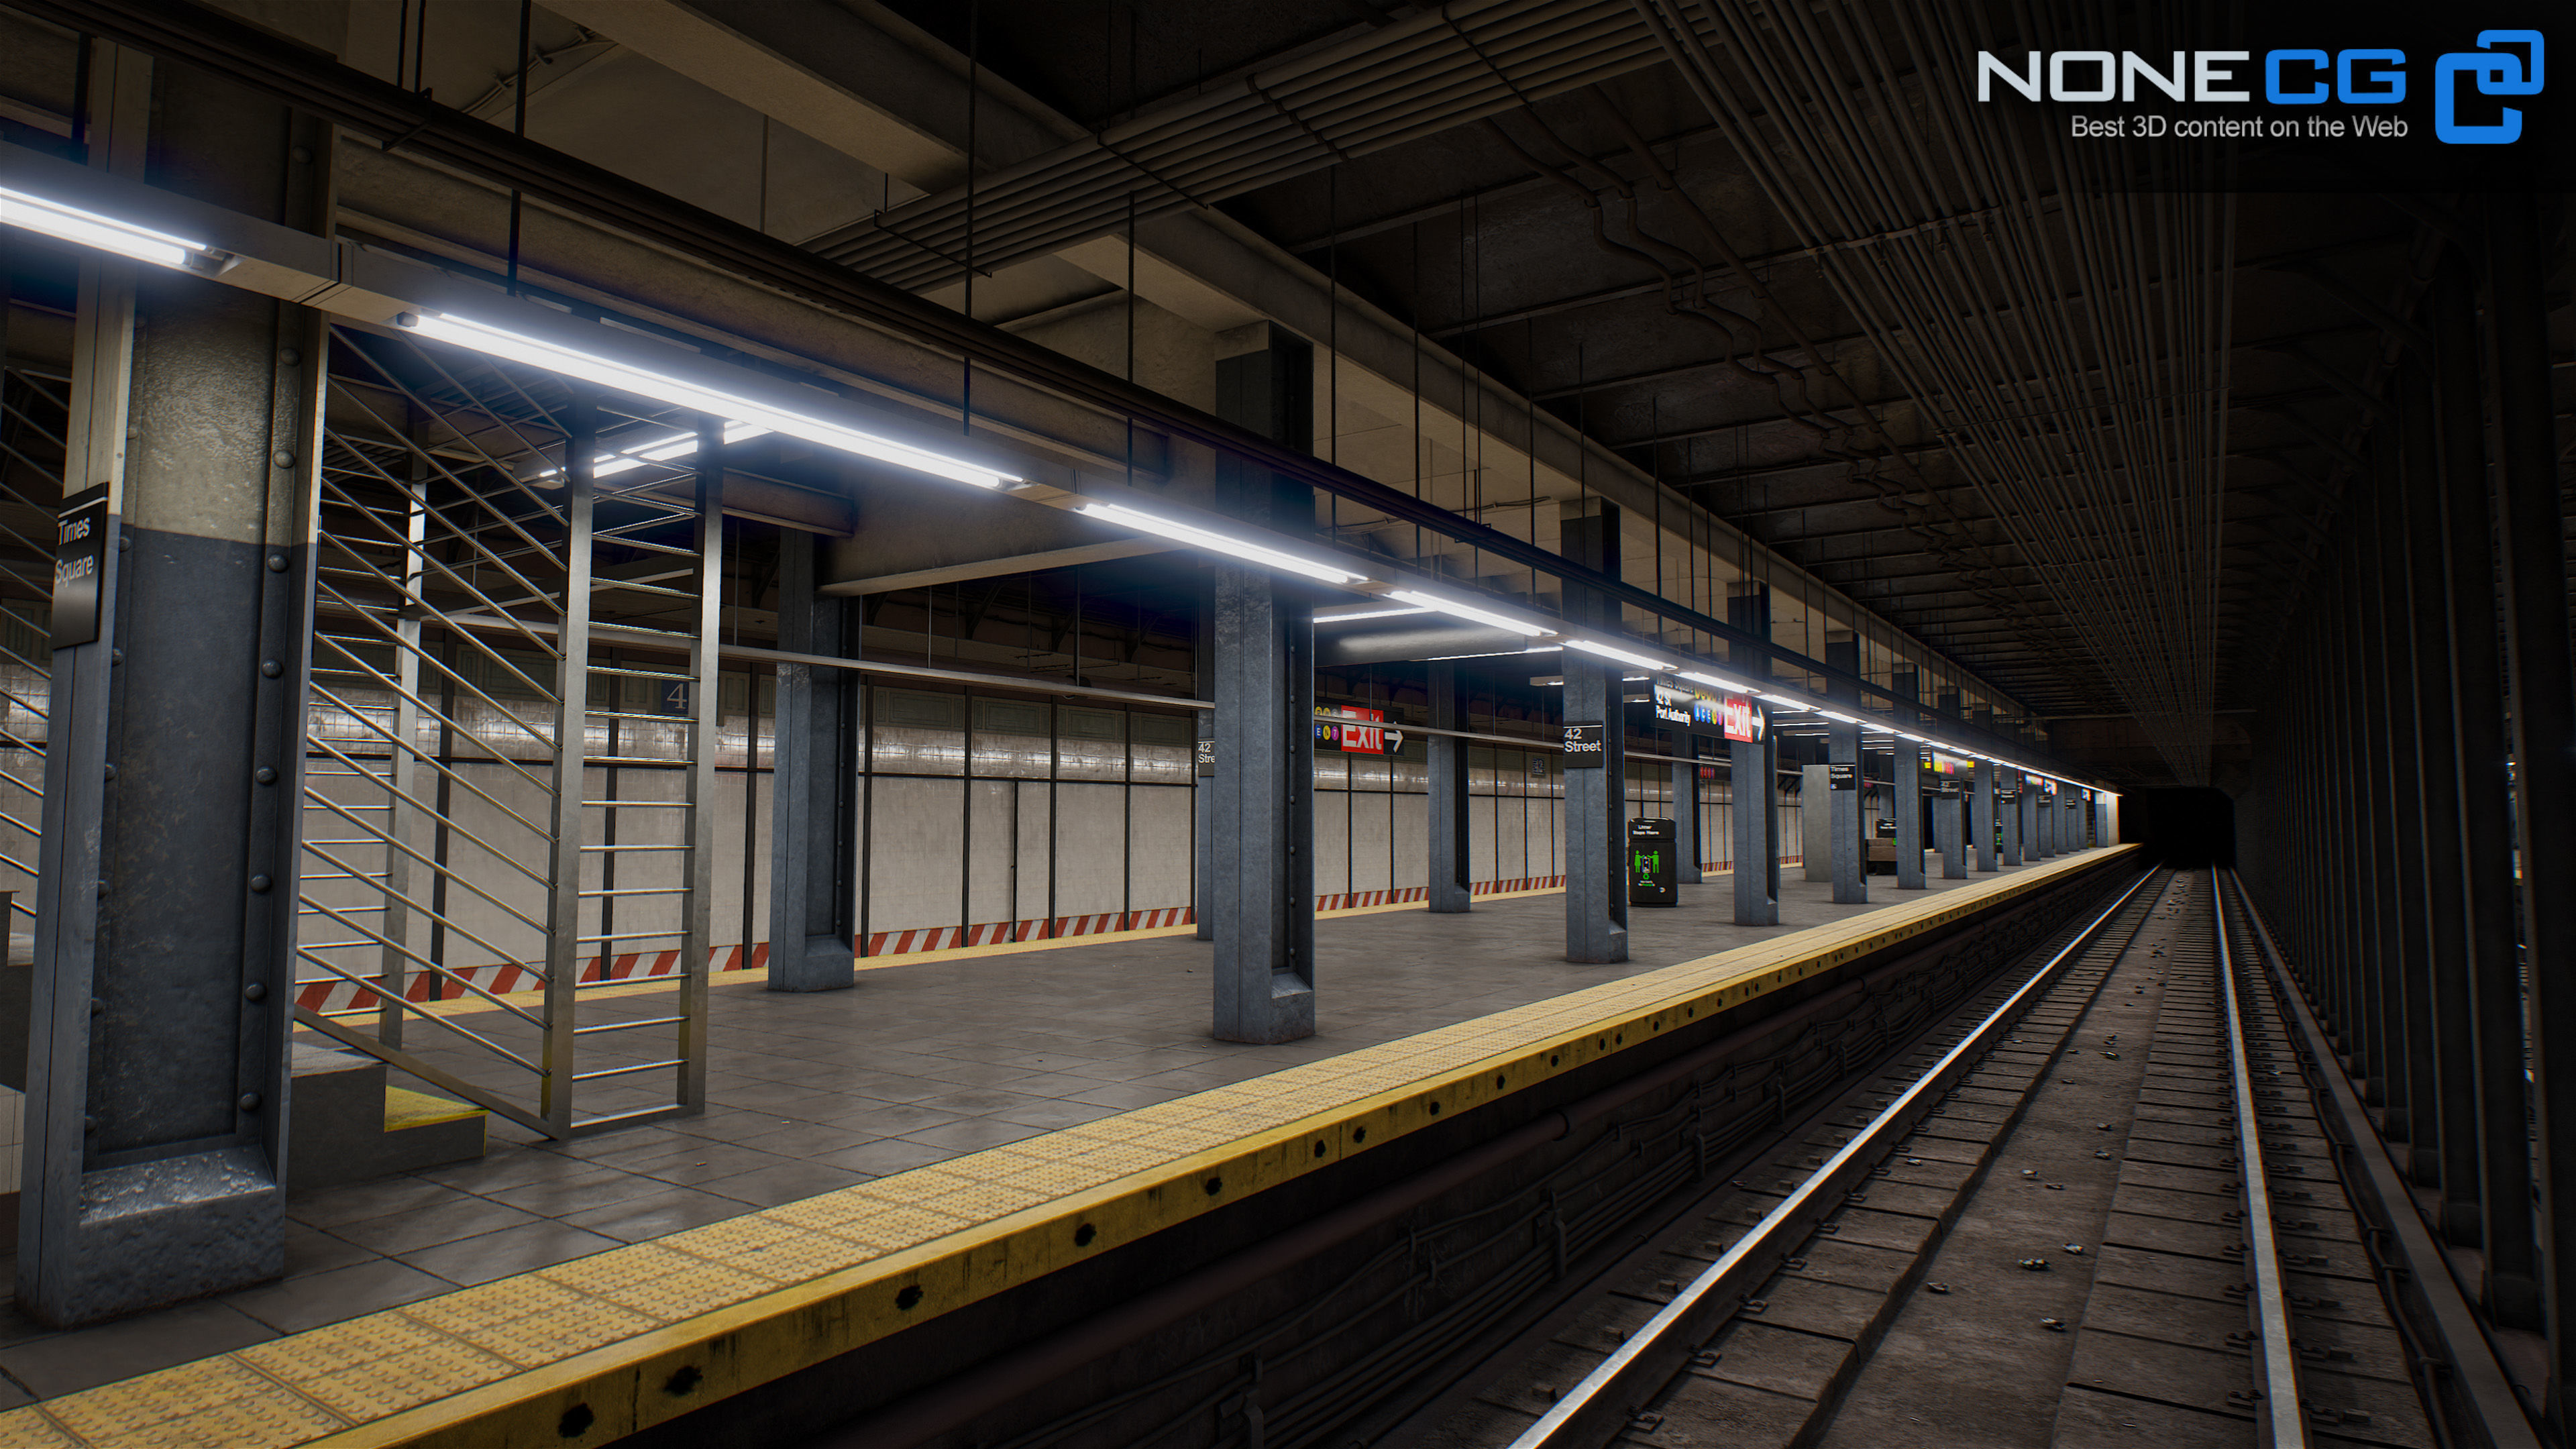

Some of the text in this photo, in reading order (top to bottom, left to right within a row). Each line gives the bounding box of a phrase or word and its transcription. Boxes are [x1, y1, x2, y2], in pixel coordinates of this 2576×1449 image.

[58, 517, 91, 545] Times
[54, 555, 94, 587] Square
[666, 683, 687, 709] 4
[1656, 705, 1691, 727] Port Authority
[1725, 692, 1751, 738] Exit
[1342, 710, 1383, 751] Exit
[1564, 728, 1582, 739] 42
[1198, 743, 1211, 753] 42
[1198, 753, 1216, 763] Stre
[1564, 740, 1602, 752] Street
